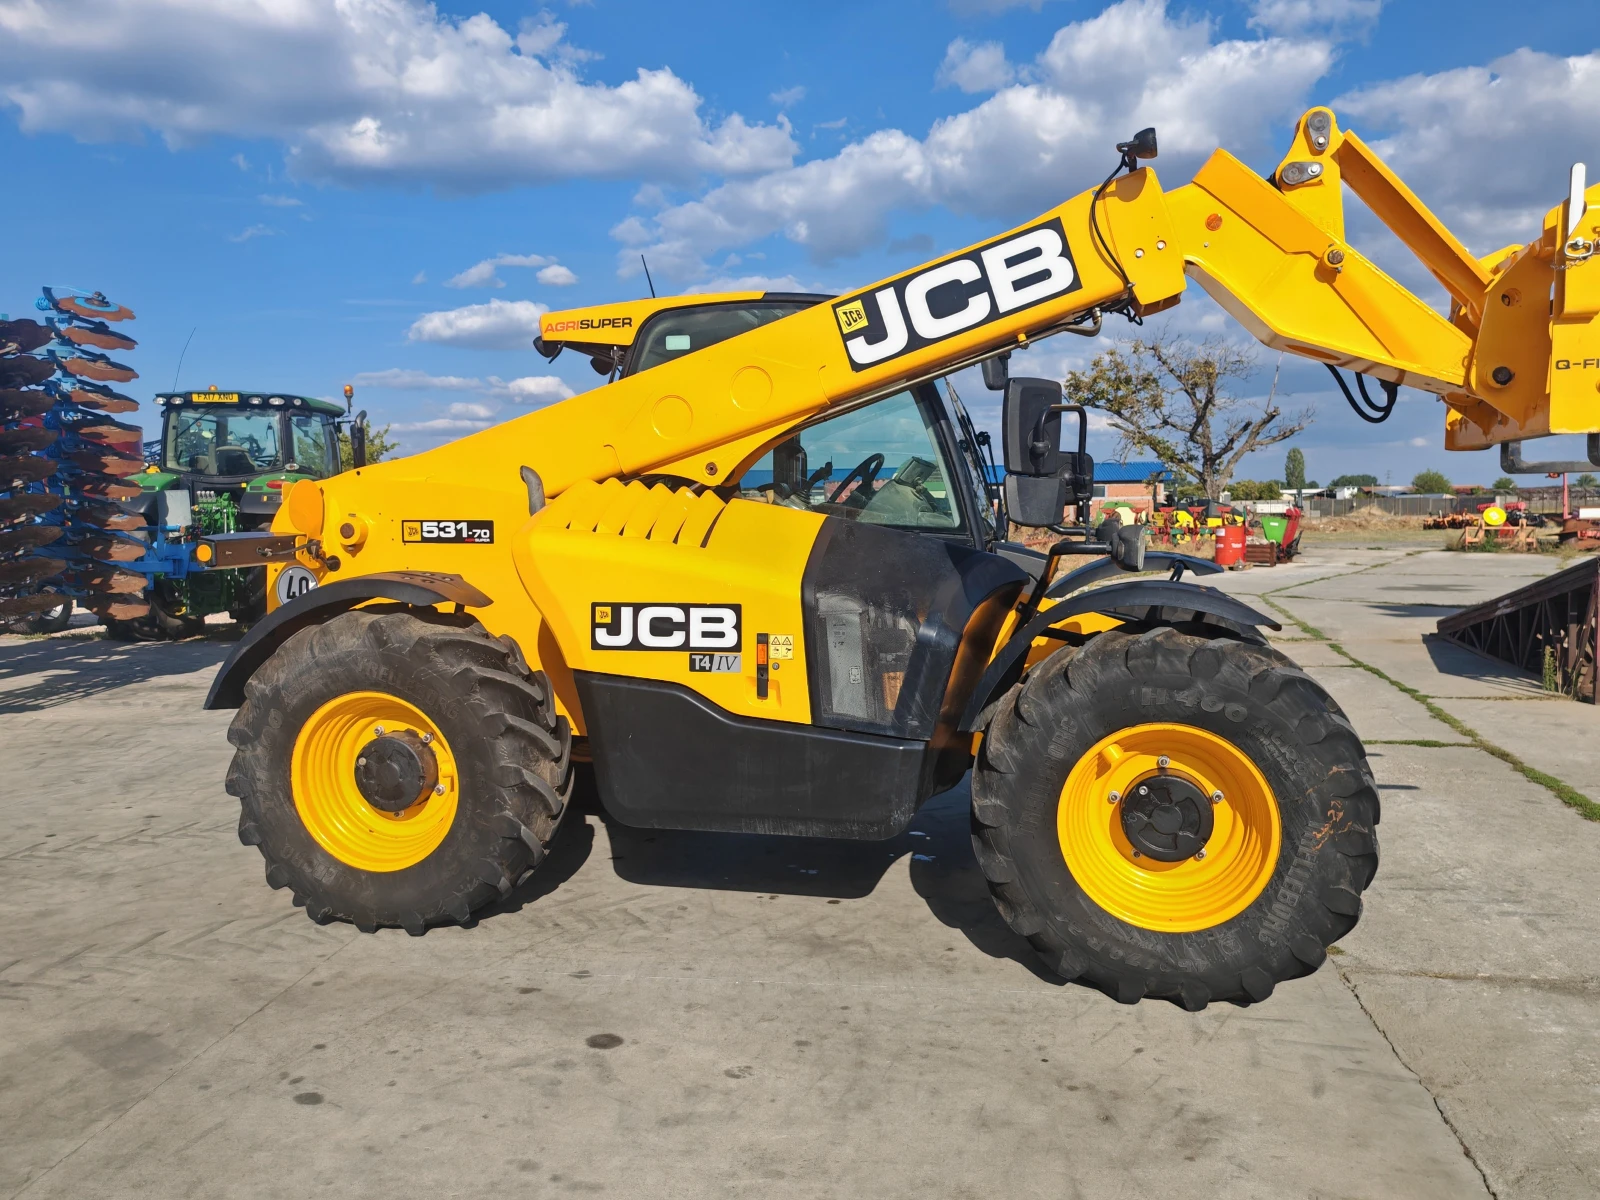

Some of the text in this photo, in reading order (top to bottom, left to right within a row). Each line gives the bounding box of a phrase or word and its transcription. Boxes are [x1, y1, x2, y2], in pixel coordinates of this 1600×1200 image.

[846, 228, 1074, 364] JCB
[544, 317, 632, 334] AGRISUPER
[842, 309, 863, 327] JCB
[422, 521, 490, 538] 531-70
[287, 575, 310, 600] 40
[595, 606, 738, 648] JCB
[692, 655, 738, 671] T4 IV
